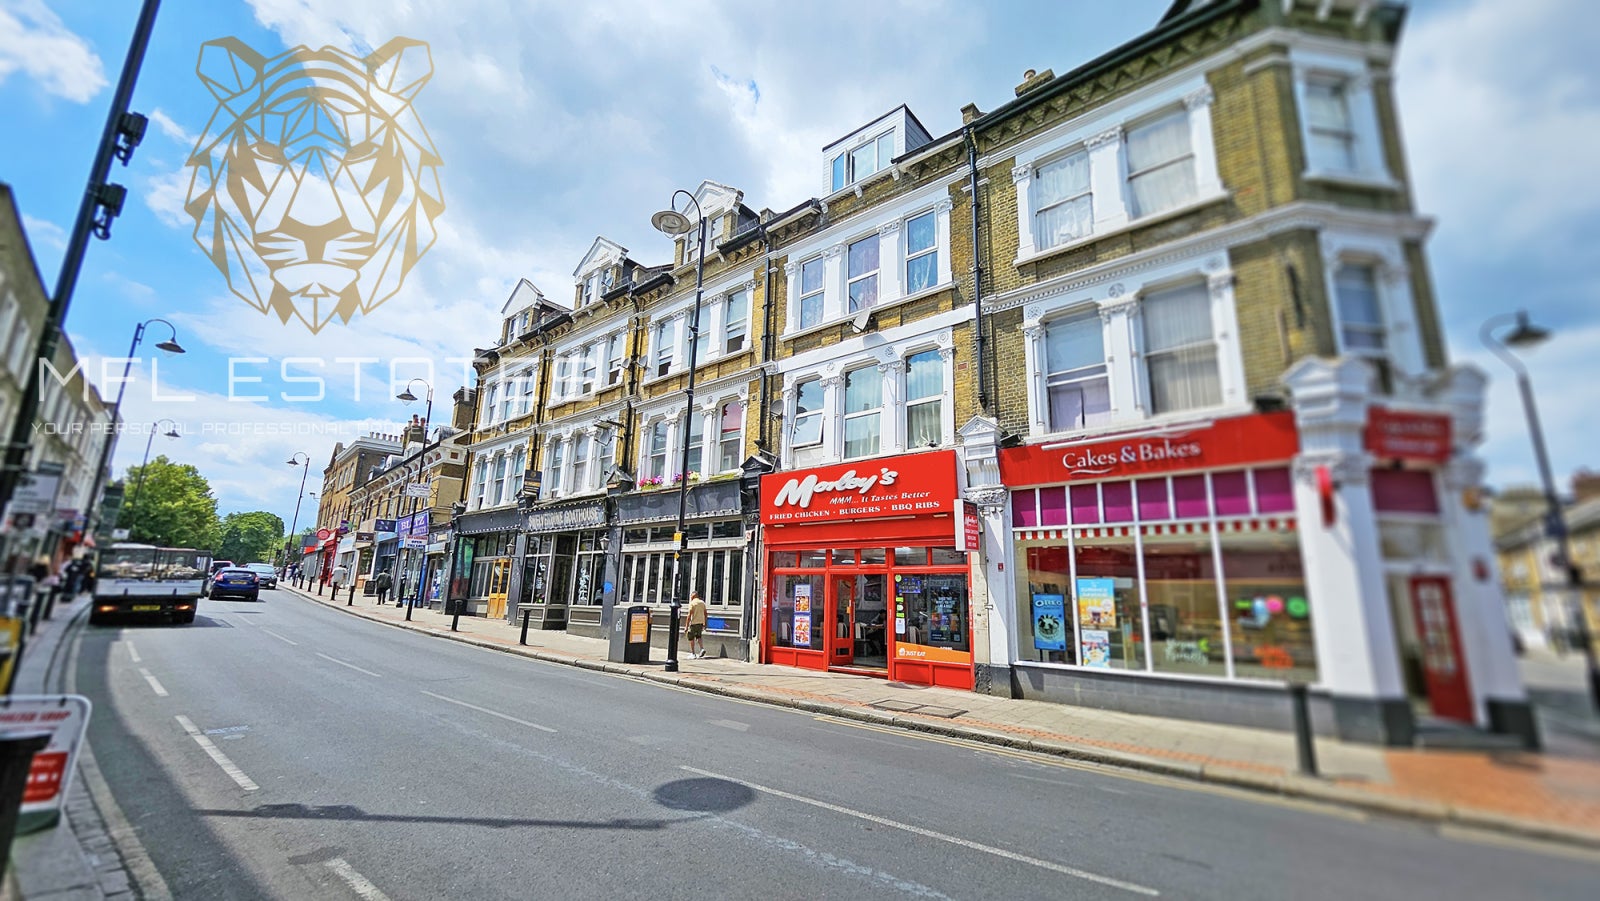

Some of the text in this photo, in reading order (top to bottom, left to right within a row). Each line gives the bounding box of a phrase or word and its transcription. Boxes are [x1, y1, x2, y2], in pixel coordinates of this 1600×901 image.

[1062, 439, 1201, 468] Cakes & Bakes
[774, 468, 898, 508] Morley's
[871, 494, 898, 502] Tastes
[901, 491, 931, 499] Better
[794, 510, 830, 519] CHICKEN
[839, 506, 881, 515] BURGERS
[891, 503, 913, 511] BBQ
[915, 501, 940, 509] RIBS
[401, 515, 424, 530] BLTZ
